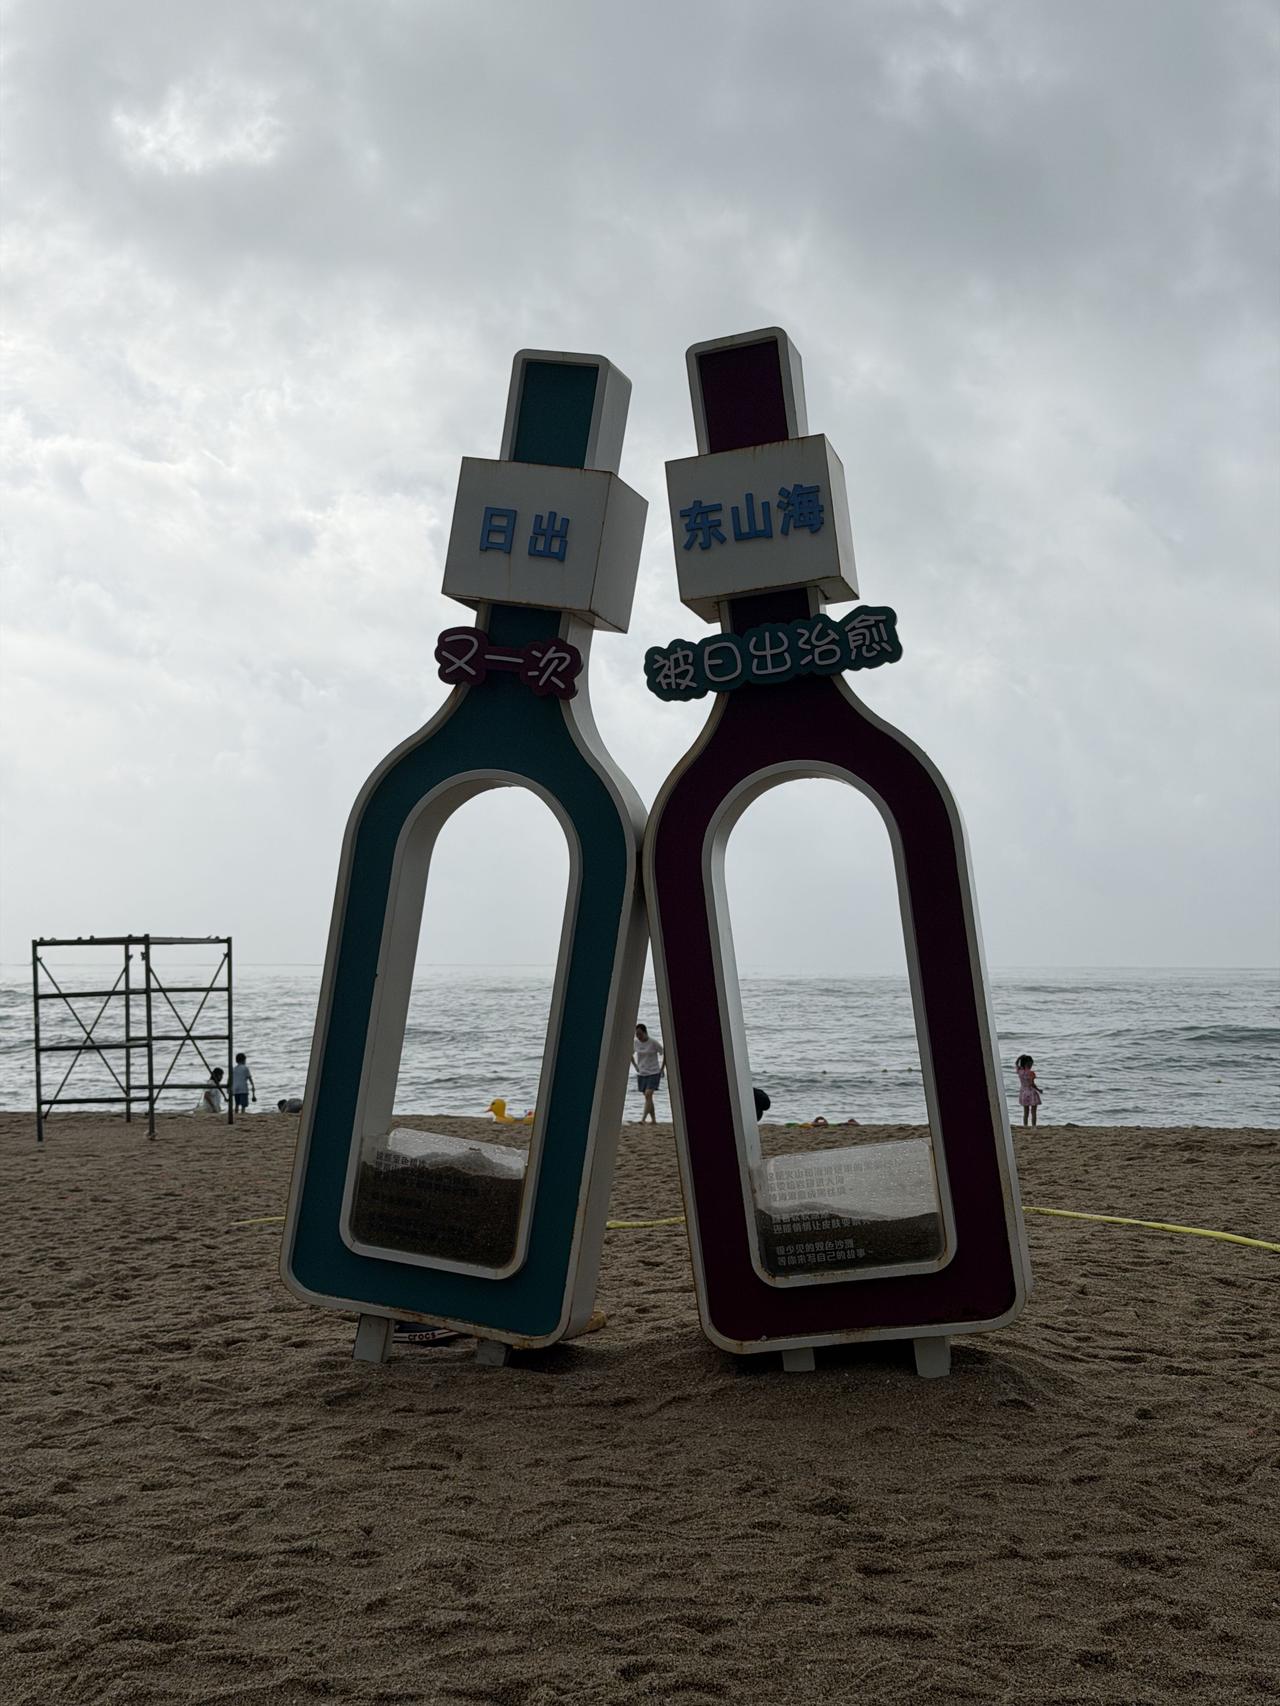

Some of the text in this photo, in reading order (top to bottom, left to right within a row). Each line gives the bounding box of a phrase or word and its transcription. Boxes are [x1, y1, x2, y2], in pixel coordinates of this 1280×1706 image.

[479, 506, 570, 563] 日出
[680, 484, 825, 551] 东山海
[441, 633, 572, 690] 又一次
[652, 614, 889, 691] 被日出治愈
[407, 1332, 436, 1341] crocs
